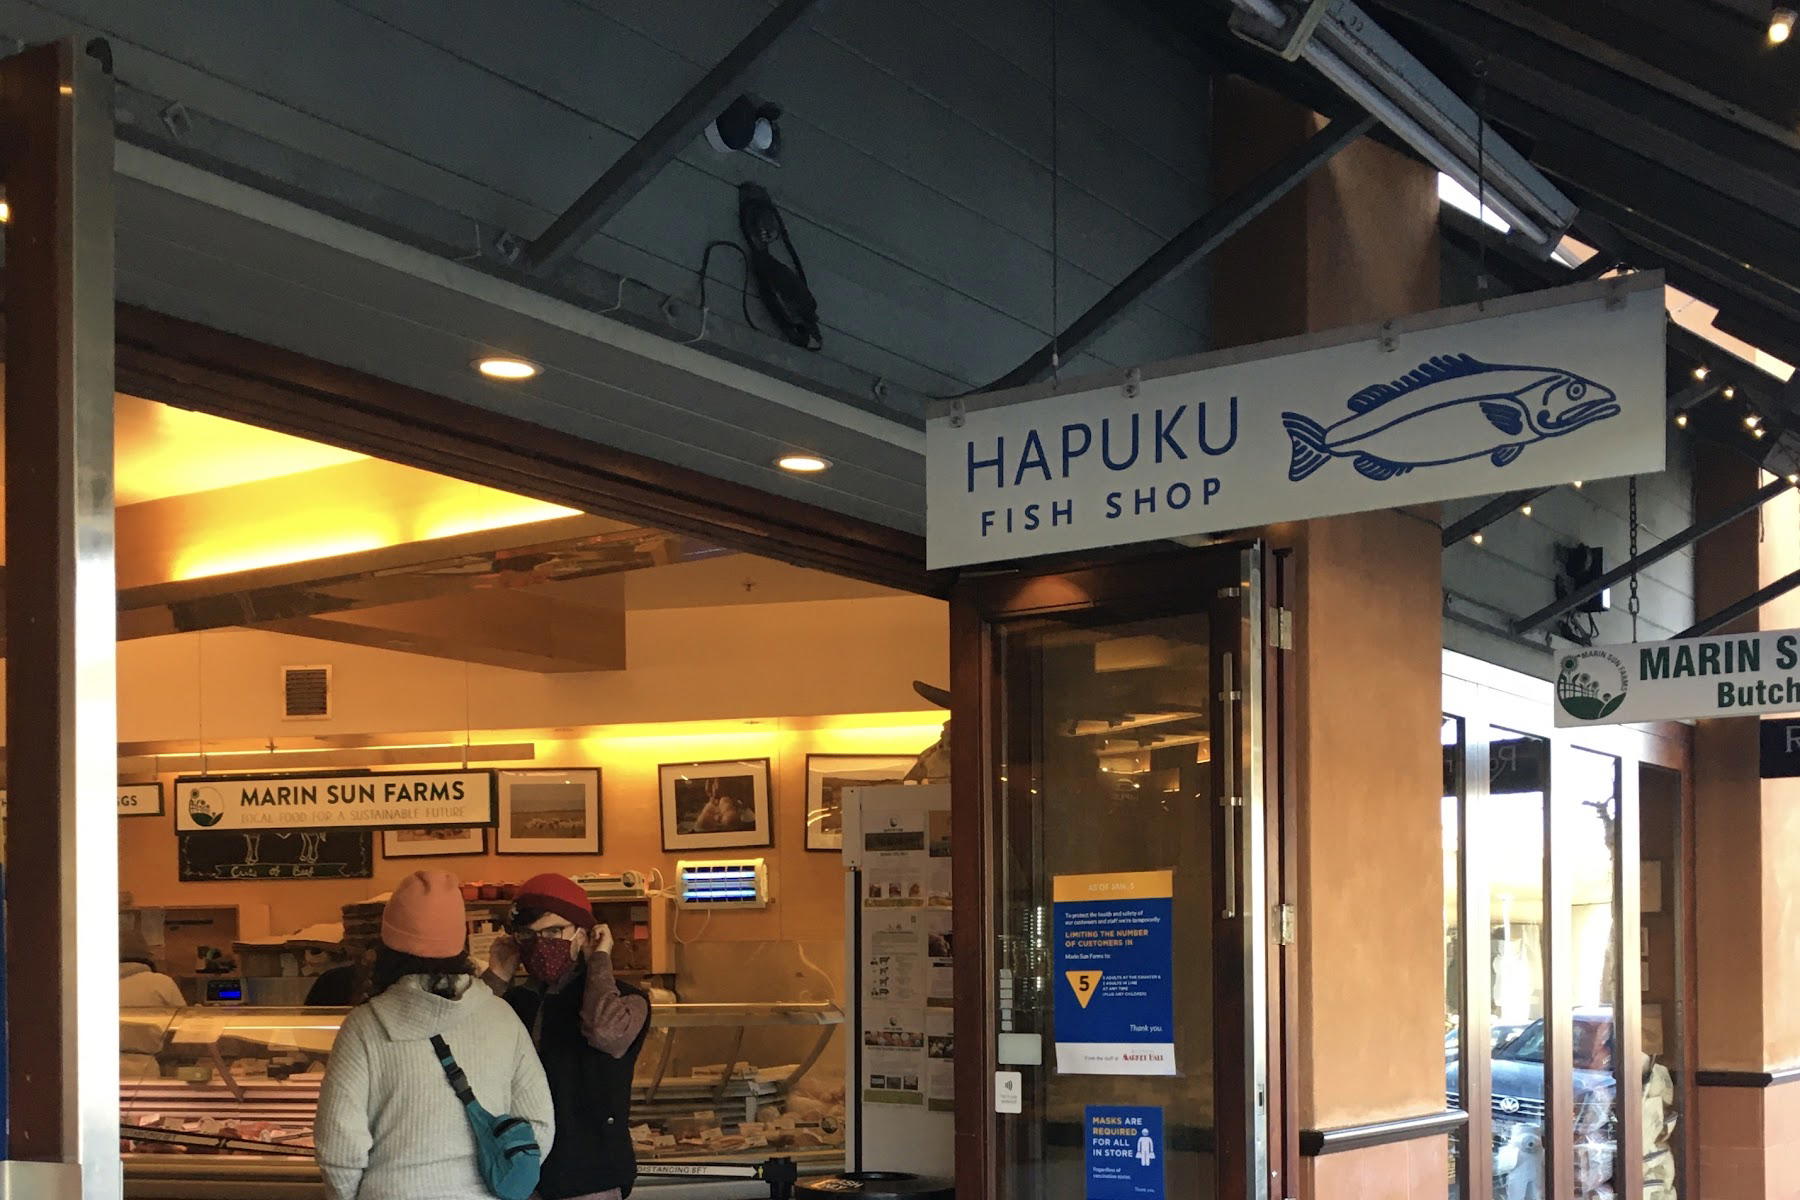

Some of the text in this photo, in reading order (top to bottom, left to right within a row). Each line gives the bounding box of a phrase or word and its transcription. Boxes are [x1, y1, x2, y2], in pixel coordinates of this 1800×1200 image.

[967, 396, 1238, 493] HAPUKU
[981, 477, 1221, 537] FISH SHOP
[1639, 638, 1761, 681] MARIN
[1717, 677, 1800, 708] Butch
[240, 780, 466, 807] MARIN SUN FARMS
[278, 810, 308, 823] FOOD
[311, 809, 332, 822] FOR
[349, 806, 419, 820] SUSTAINABLE
[425, 805, 466, 818] FUTURE
[1065, 928, 1149, 939] LIMITING THE NUMBER
[1064, 938, 1134, 948] OF CUSTOMERS IN
[1078, 975, 1090, 992] 5
[1129, 1024, 1149, 1032] Thank
[1092, 1116, 1143, 1126] MASKS ARE
[1092, 1127, 1138, 1136] REQUIRED
[1092, 1138, 1130, 1147] FOR ALL
[1092, 1148, 1134, 1158] IN STORE
